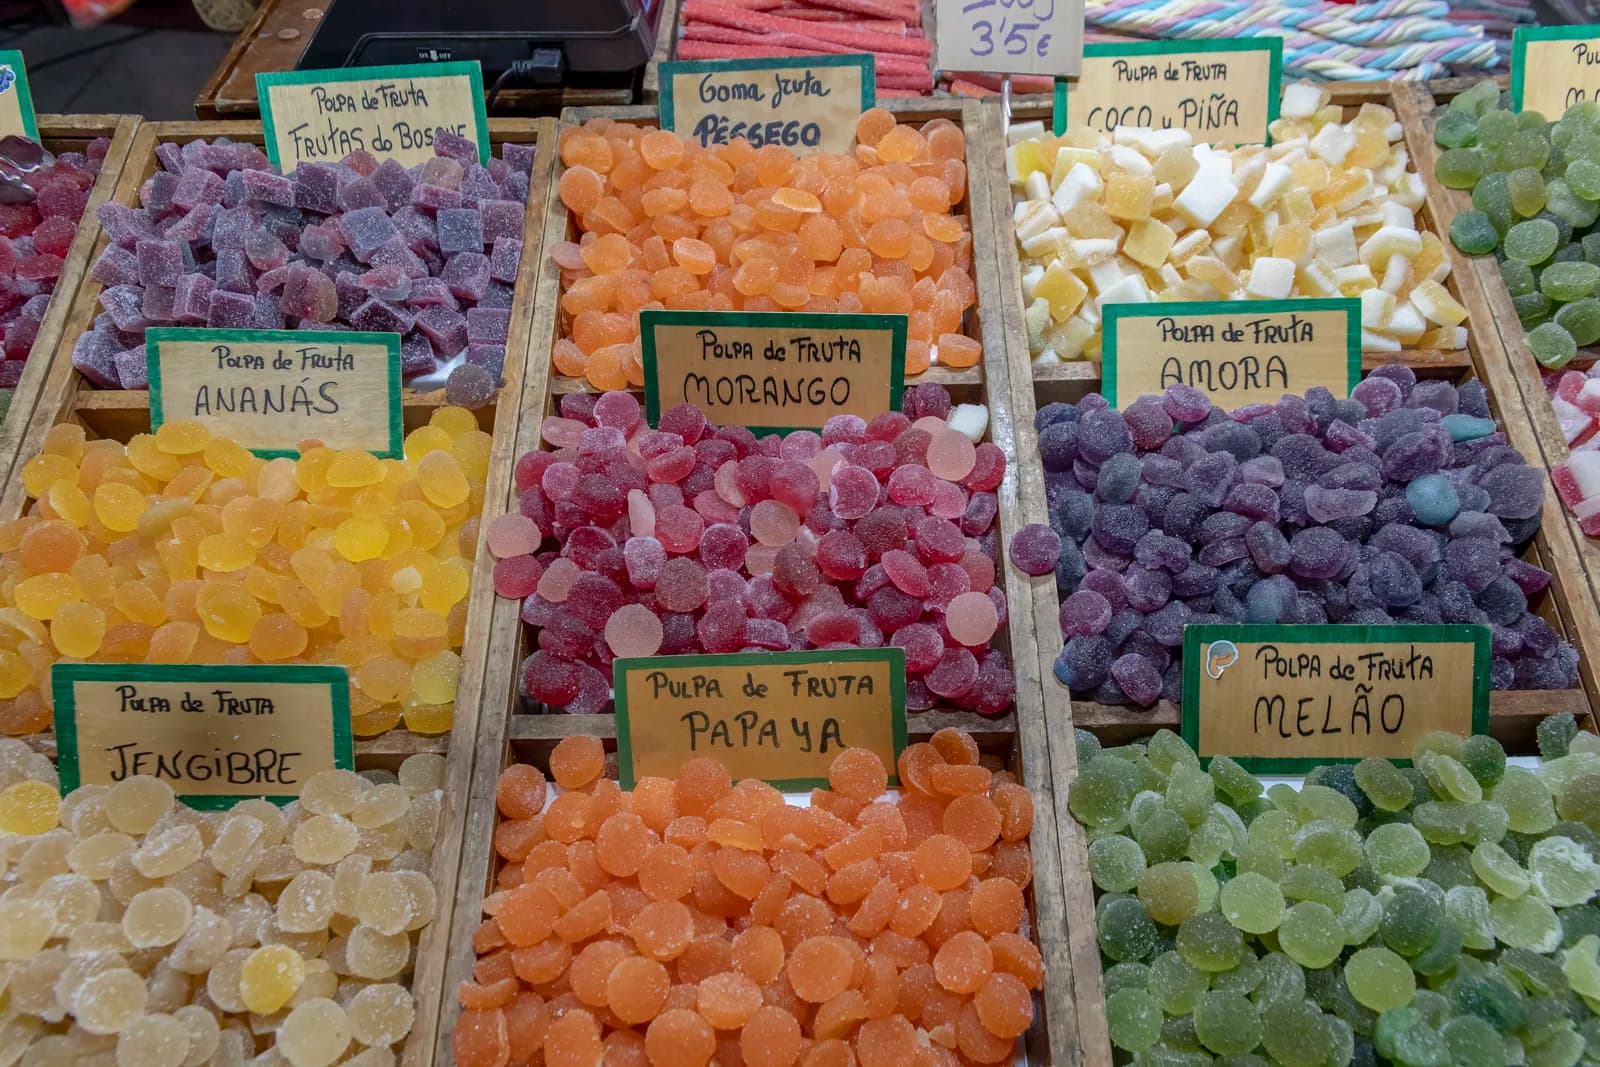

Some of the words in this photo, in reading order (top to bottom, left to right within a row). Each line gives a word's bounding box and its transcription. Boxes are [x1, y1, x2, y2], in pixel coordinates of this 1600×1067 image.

[1112, 59, 1158, 82] PULPA
[1163, 61, 1180, 81] de
[1181, 60, 1227, 81] FRUTA
[361, 89, 380, 111] de
[699, 73, 765, 104] Goma
[371, 124, 393, 152] do
[1221, 321, 1245, 343] de
[272, 349, 293, 370] de
[763, 339, 786, 362] de
[1160, 354, 1289, 392] AMORA
[194, 377, 340, 416] ANANÁS
[683, 372, 851, 407] MORANGO
[1329, 655, 1355, 681] de
[645, 671, 724, 699] PULPA
[742, 672, 769, 699] de
[783, 669, 874, 699] FRUTA
[180, 691, 205, 713] de
[211, 689, 275, 716] FRUTA
[1254, 683, 1405, 738] MELÃO
[680, 710, 847, 753] PAPAYA
